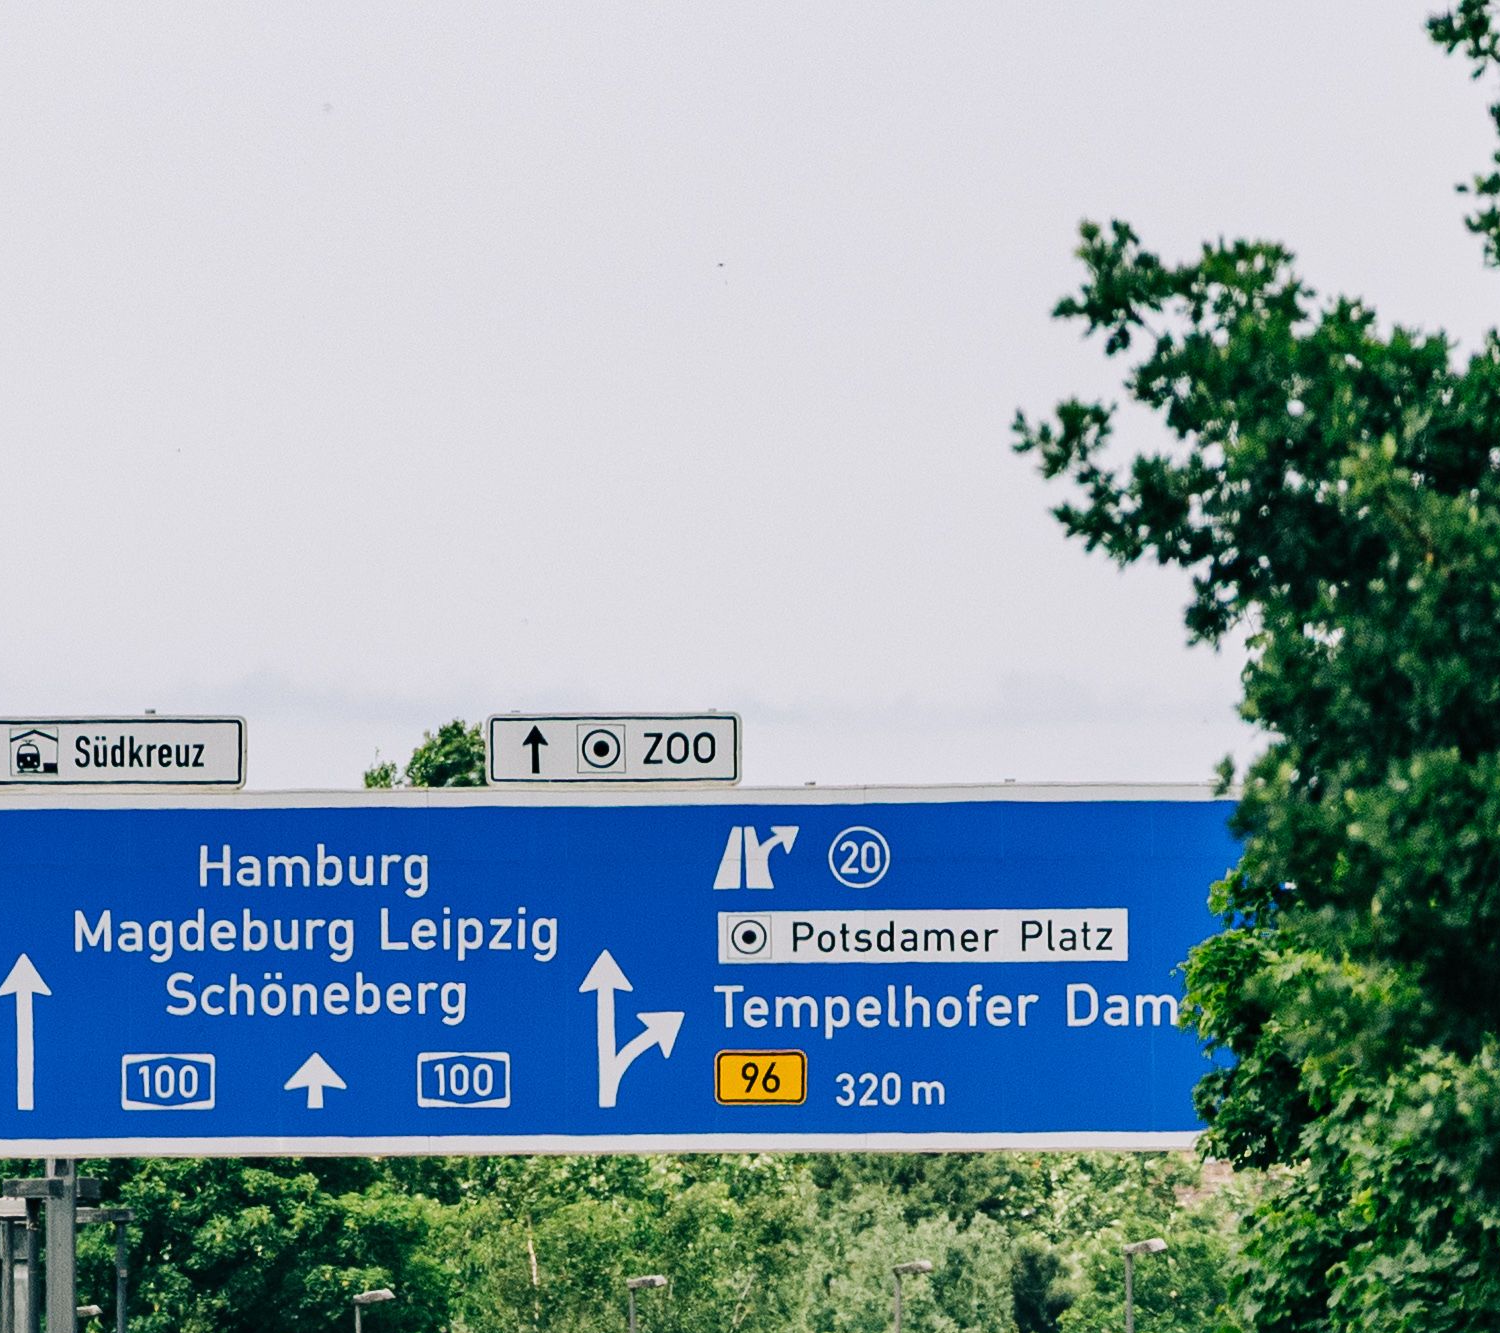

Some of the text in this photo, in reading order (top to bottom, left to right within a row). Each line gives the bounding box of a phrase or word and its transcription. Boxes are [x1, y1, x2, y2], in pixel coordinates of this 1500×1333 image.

[74, 735, 205, 768] Südkreuz
[642, 731, 716, 765] ZOO
[199, 843, 429, 898] Hamburg
[840, 840, 881, 875] 20
[74, 906, 558, 963] Magdeburg Leipzig
[792, 920, 1114, 953] Potsdamer Platz
[166, 971, 466, 1026] Schöneberg
[713, 983, 1179, 1040] Tempelhofer Dam
[138, 1064, 199, 1099] 100
[433, 1063, 494, 1098] 100
[741, 1062, 781, 1093] 96
[835, 1072, 945, 1107] 320 m
